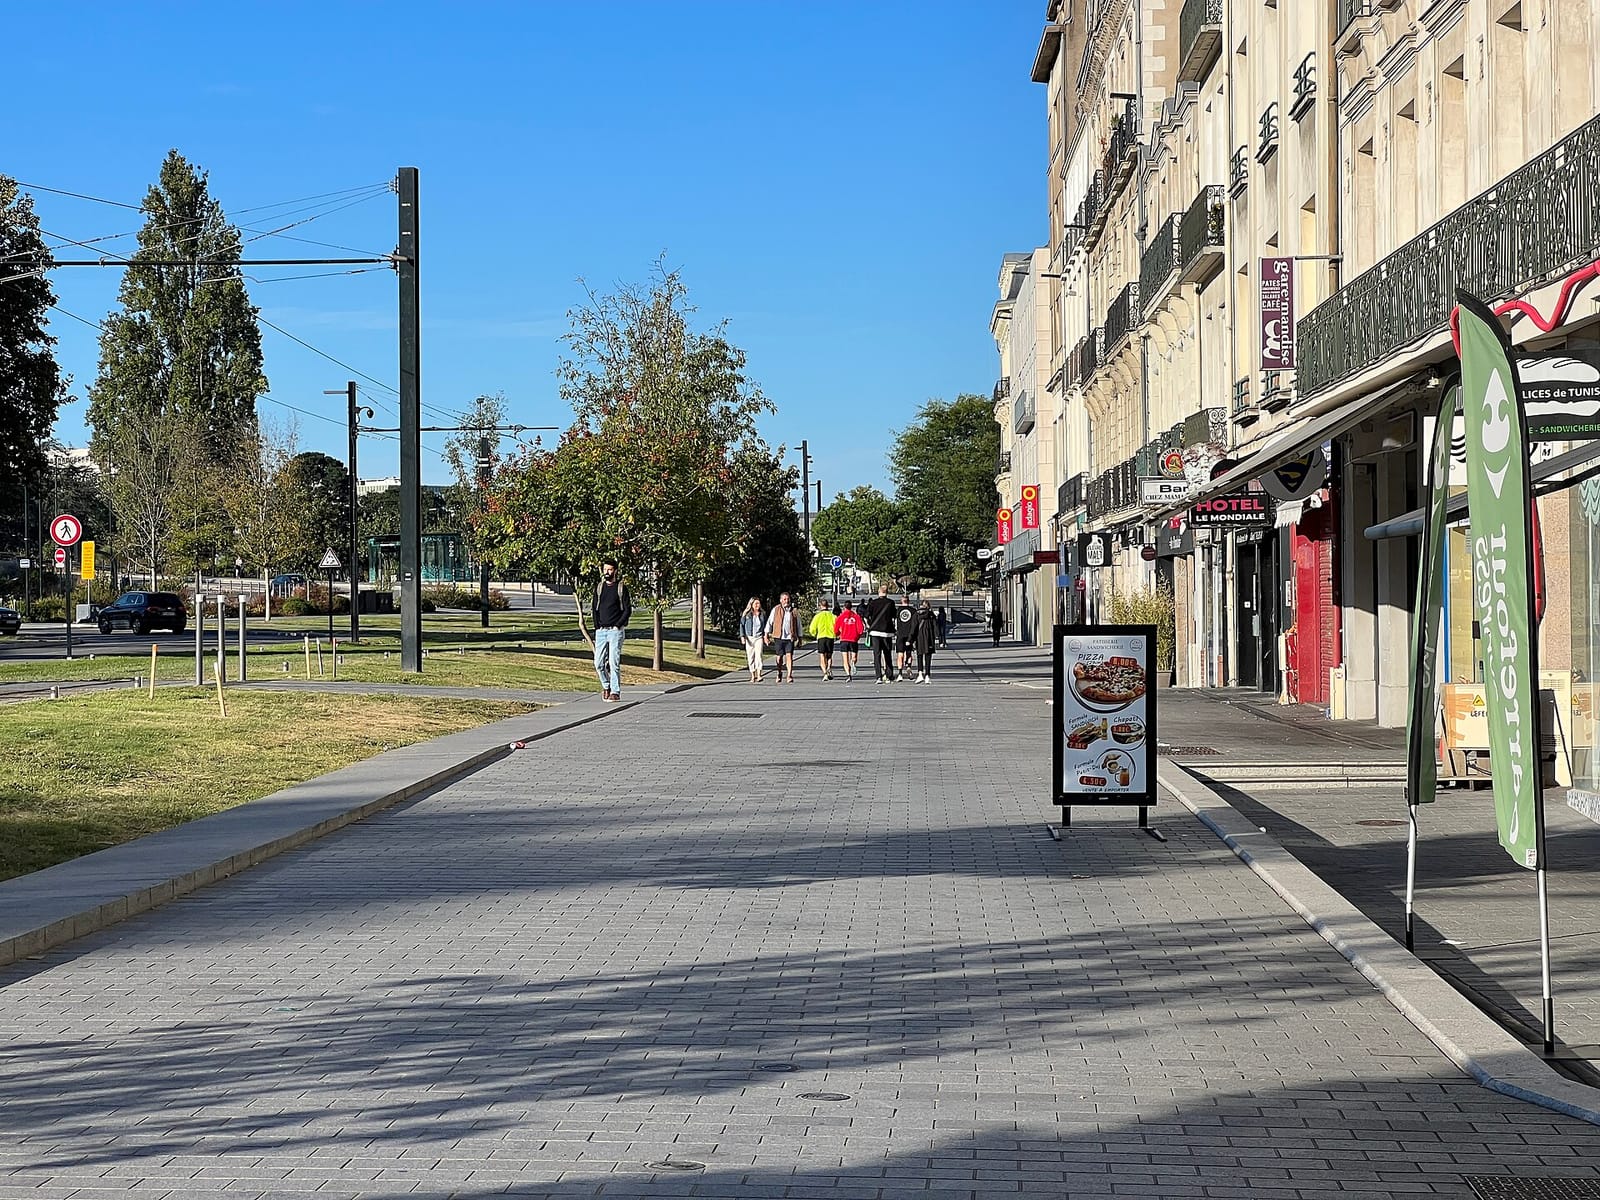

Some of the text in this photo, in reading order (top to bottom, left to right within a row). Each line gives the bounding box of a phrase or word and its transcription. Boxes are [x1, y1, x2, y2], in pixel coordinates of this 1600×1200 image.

[1273, 260, 1293, 366] gare'mandise
[1522, 389, 1551, 399] LICES
[1553, 388, 1567, 398] de
[1196, 499, 1265, 512] HOTEL
[1195, 513, 1266, 522] LE MONDIALE
[1077, 653, 1104, 661] PIZZA
